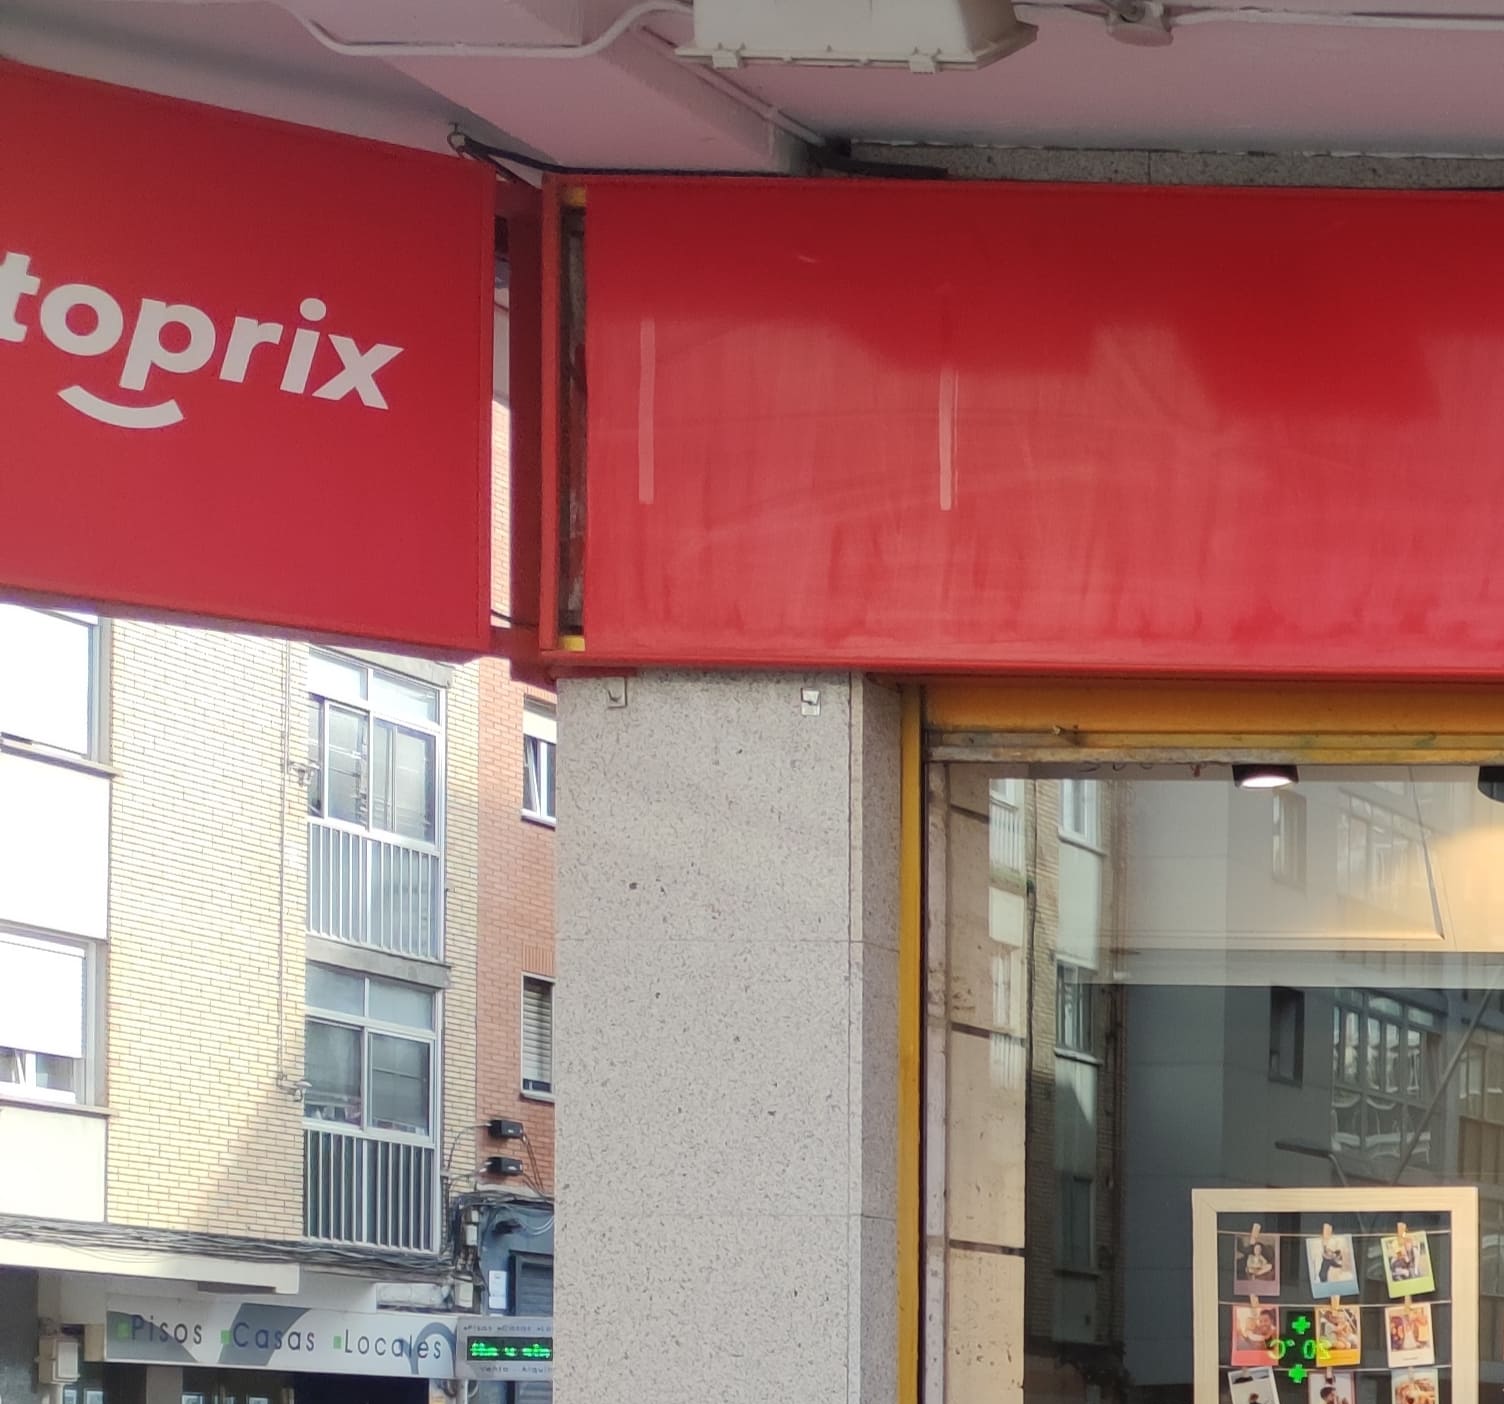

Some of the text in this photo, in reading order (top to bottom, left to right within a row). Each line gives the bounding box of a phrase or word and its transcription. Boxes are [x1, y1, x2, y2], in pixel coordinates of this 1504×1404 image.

[130, 1314, 203, 1347] Pisos
[231, 1320, 316, 1353] Casas
[343, 1330, 442, 1360] Locales
